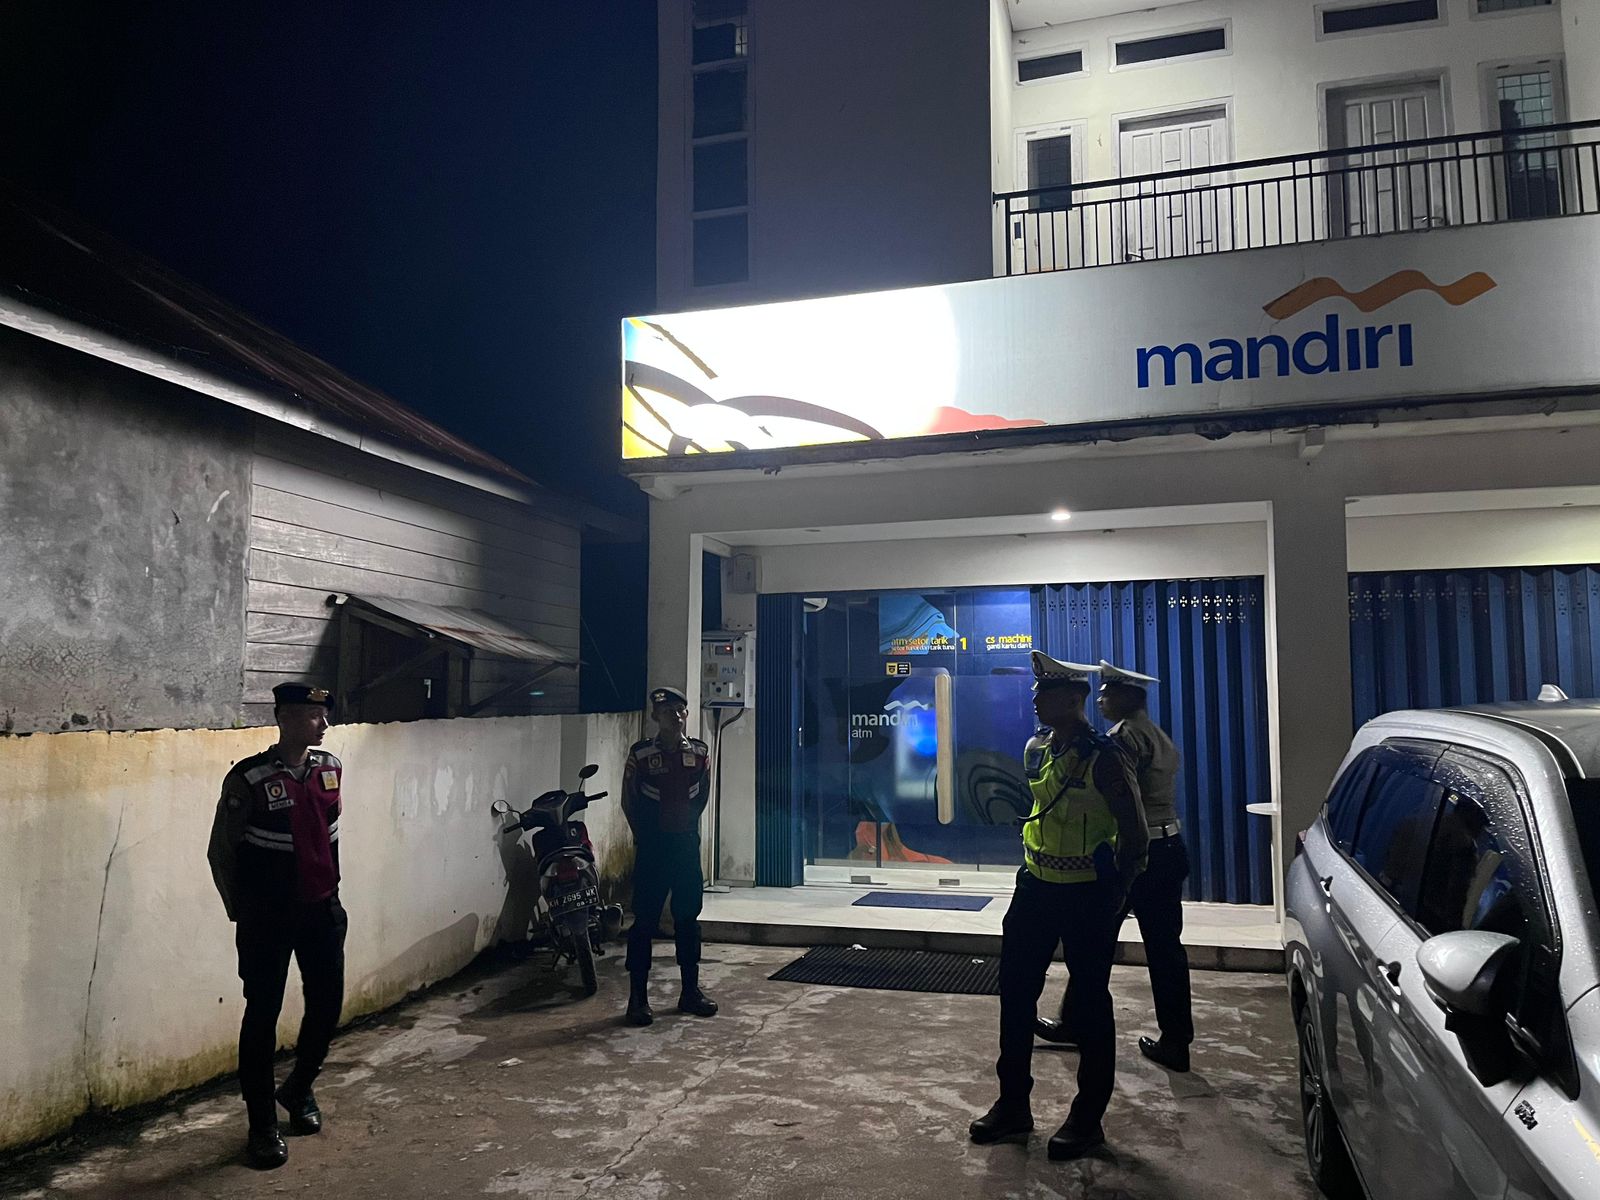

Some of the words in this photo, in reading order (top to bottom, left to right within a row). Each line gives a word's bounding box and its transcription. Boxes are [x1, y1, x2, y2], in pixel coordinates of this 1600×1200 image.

[1137, 314, 1414, 388] mandiri
[960, 637, 968, 651] 1
[985, 636, 995, 644] cs
[851, 728, 873, 738] atm
